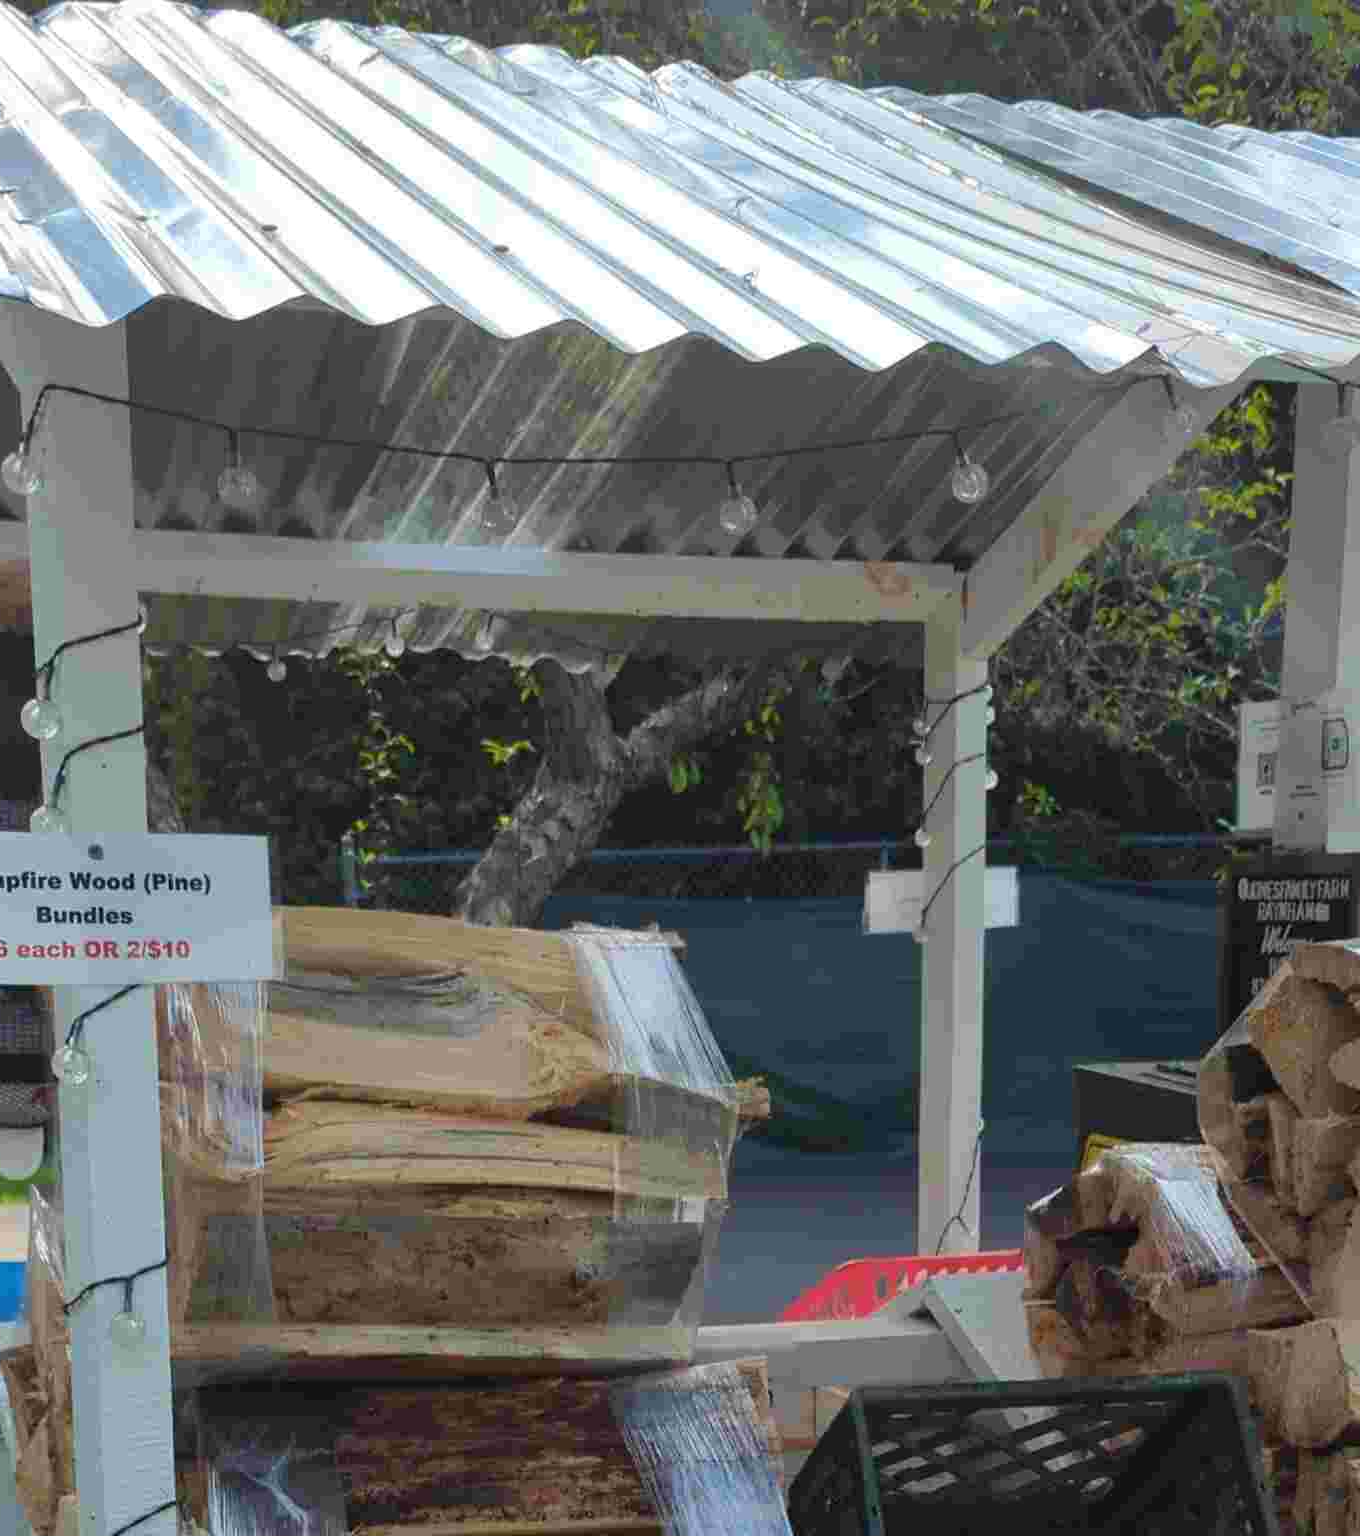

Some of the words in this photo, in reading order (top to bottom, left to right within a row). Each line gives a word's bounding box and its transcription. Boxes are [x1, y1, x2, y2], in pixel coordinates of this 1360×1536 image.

[69, 872, 136, 891] Wood
[143, 873, 211, 896] (Pine)
[36, 906, 134, 925] Bundles
[16, 941, 76, 960] each
[83, 940, 120, 960] OR
[127, 939, 192, 960] 2/$10
